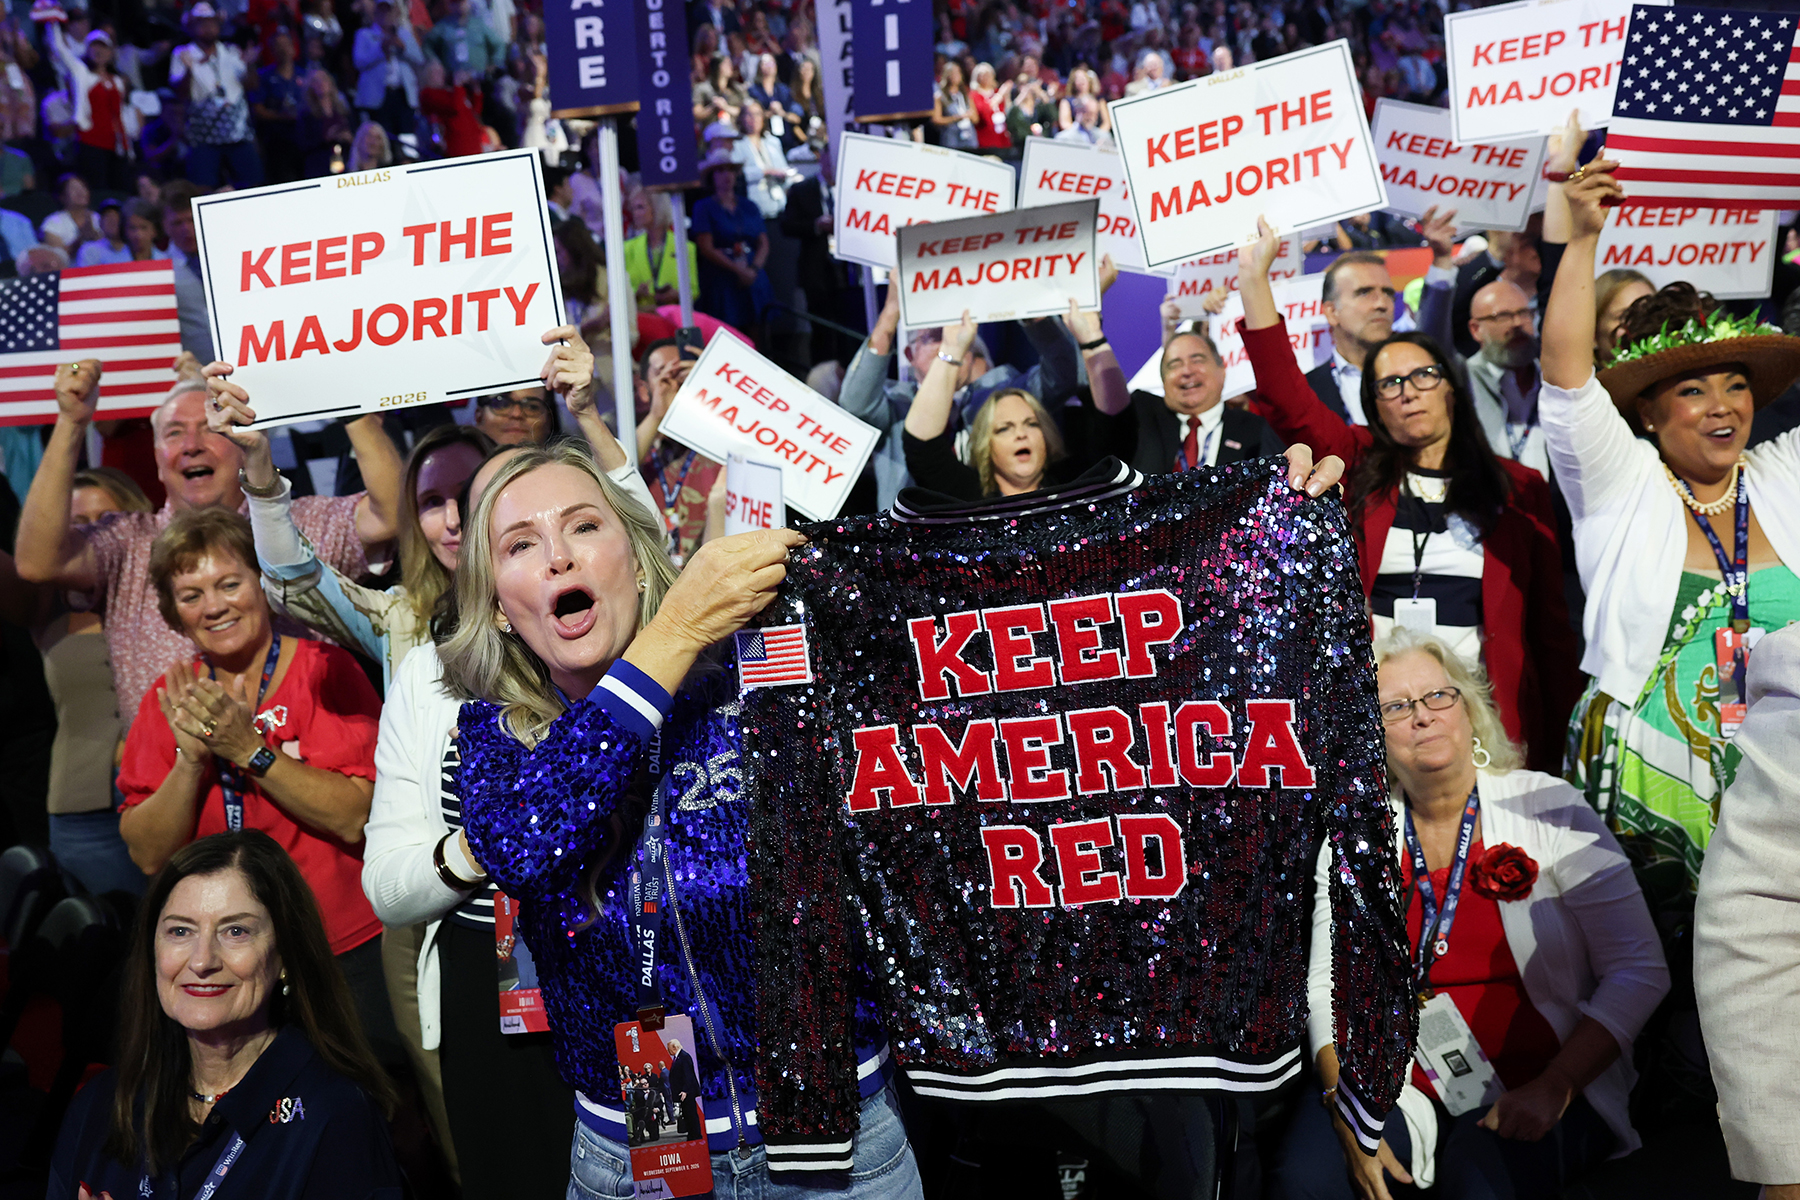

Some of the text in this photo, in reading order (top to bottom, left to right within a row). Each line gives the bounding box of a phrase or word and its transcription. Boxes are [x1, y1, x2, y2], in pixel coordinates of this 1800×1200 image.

[1473, 15, 1626, 67] KEEP TH
[646, 0, 678, 173] UERTO RICO
[1466, 59, 1623, 109] MAJORI
[1146, 89, 1333, 168] KEEP THE
[336, 170, 392, 189] DALLAS
[1150, 137, 1355, 222] MAJORITY
[1472, 144, 1528, 169] THE
[855, 169, 1000, 213] KEEP THE
[1038, 169, 1112, 199] KEEP
[1379, 163, 1527, 202] MAJORITY
[240, 212, 514, 292] KEEP THE
[917, 221, 1079, 258] KEEP THE
[1602, 241, 1767, 266] MAJORITY
[912, 252, 1086, 293] MAJORITY
[238, 282, 541, 367] MAJORITY
[379, 391, 428, 408] 2026
[715, 362, 790, 413] KEEP
[796, 413, 852, 455] THE
[693, 388, 844, 486] MAJORITY
[741, 495, 773, 529] THE
[907, 588, 1185, 701] KEEP
[648, 726, 662, 774] DALLA
[847, 699, 1317, 813] AMERICA
[673, 749, 746, 811] 25
[980, 813, 1188, 908] RED
[1457, 823, 1473, 860] DALLAS
[651, 876, 659, 901] TRUST
[641, 929, 655, 987] DALLAS
[659, 1152, 681, 1167] IOWA
